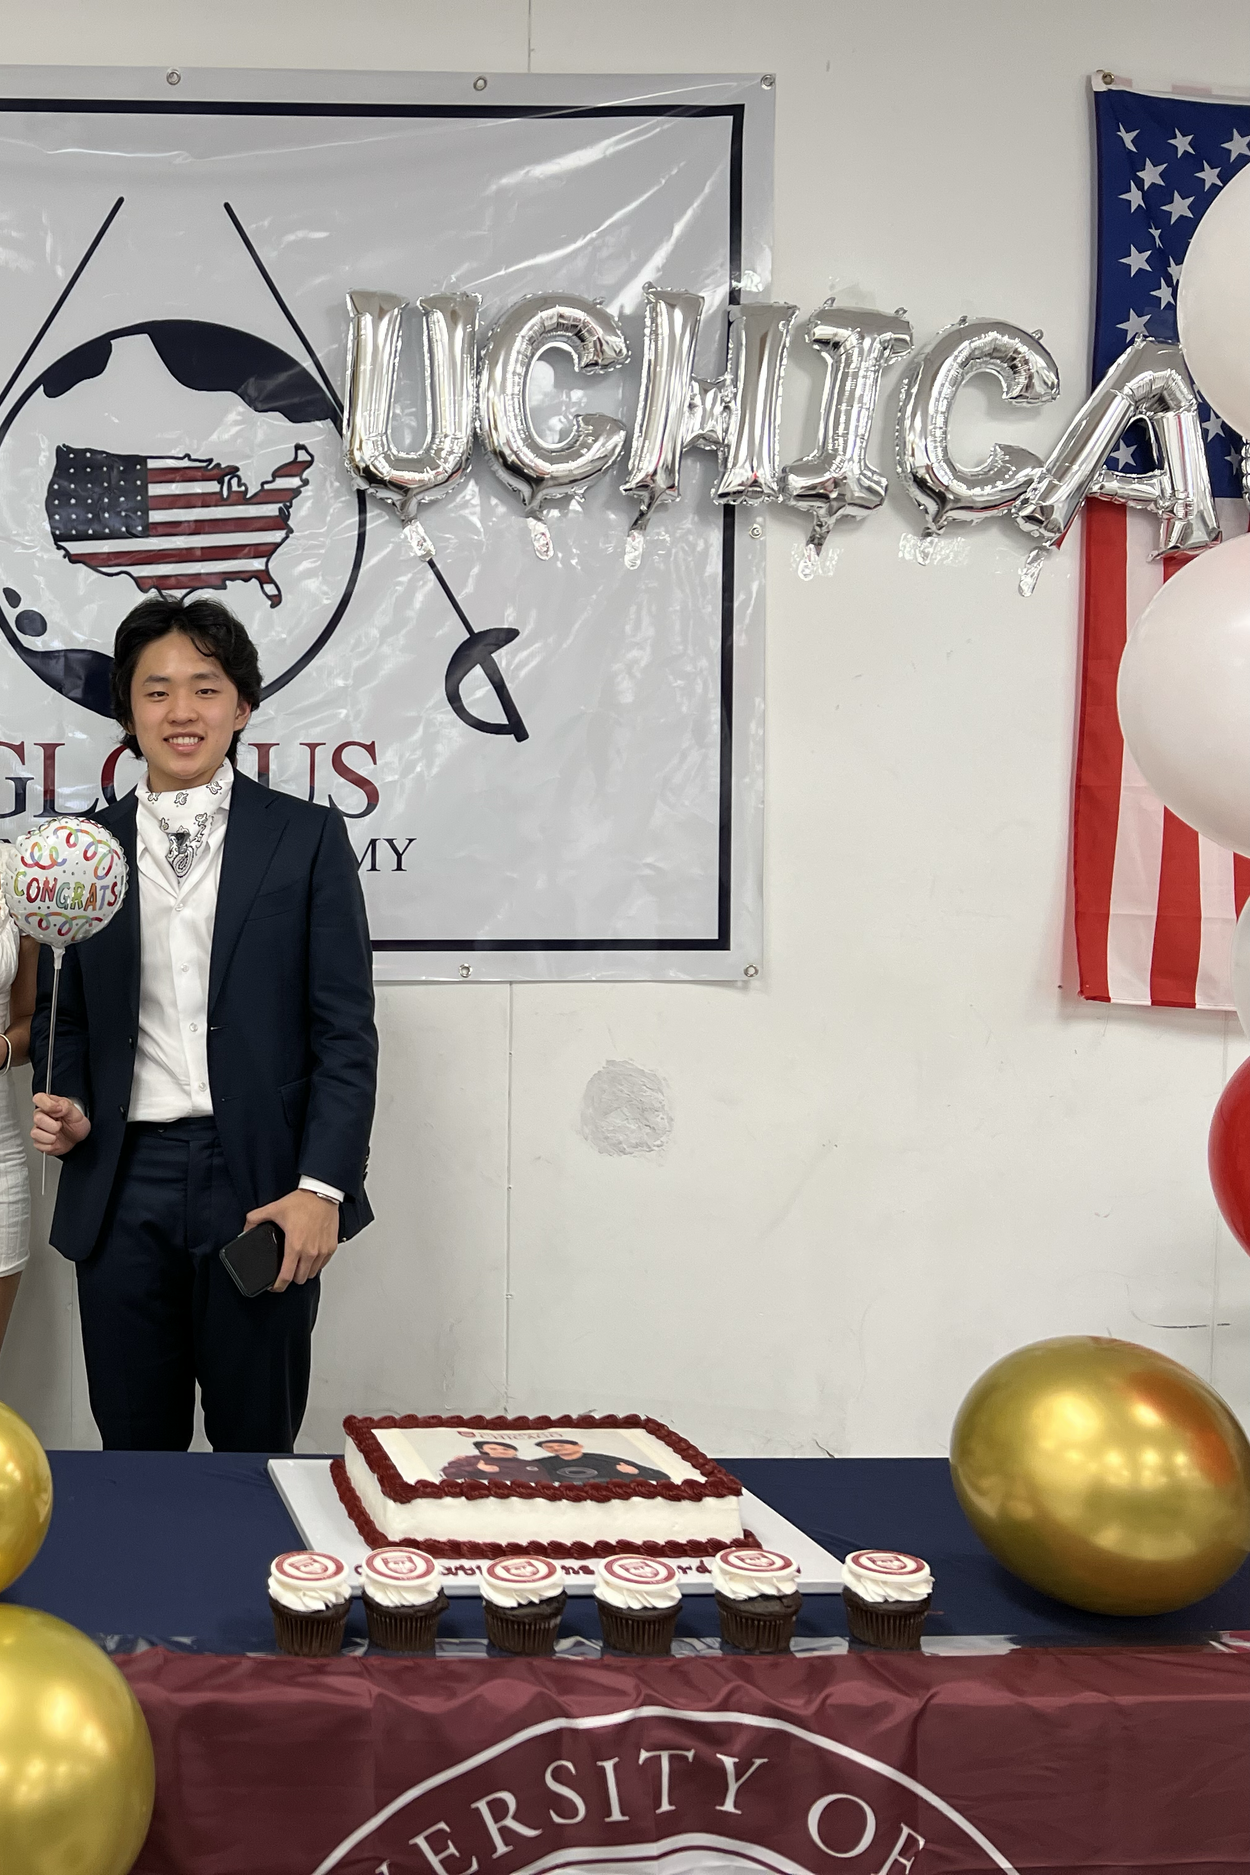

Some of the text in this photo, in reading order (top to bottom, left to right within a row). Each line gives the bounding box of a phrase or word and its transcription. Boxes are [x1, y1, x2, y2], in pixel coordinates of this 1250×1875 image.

[344, 283, 1250, 561] UCHICA
[13, 870, 118, 912] CONGRATS
[375, 1747, 926, 1875] ERSITY OF
